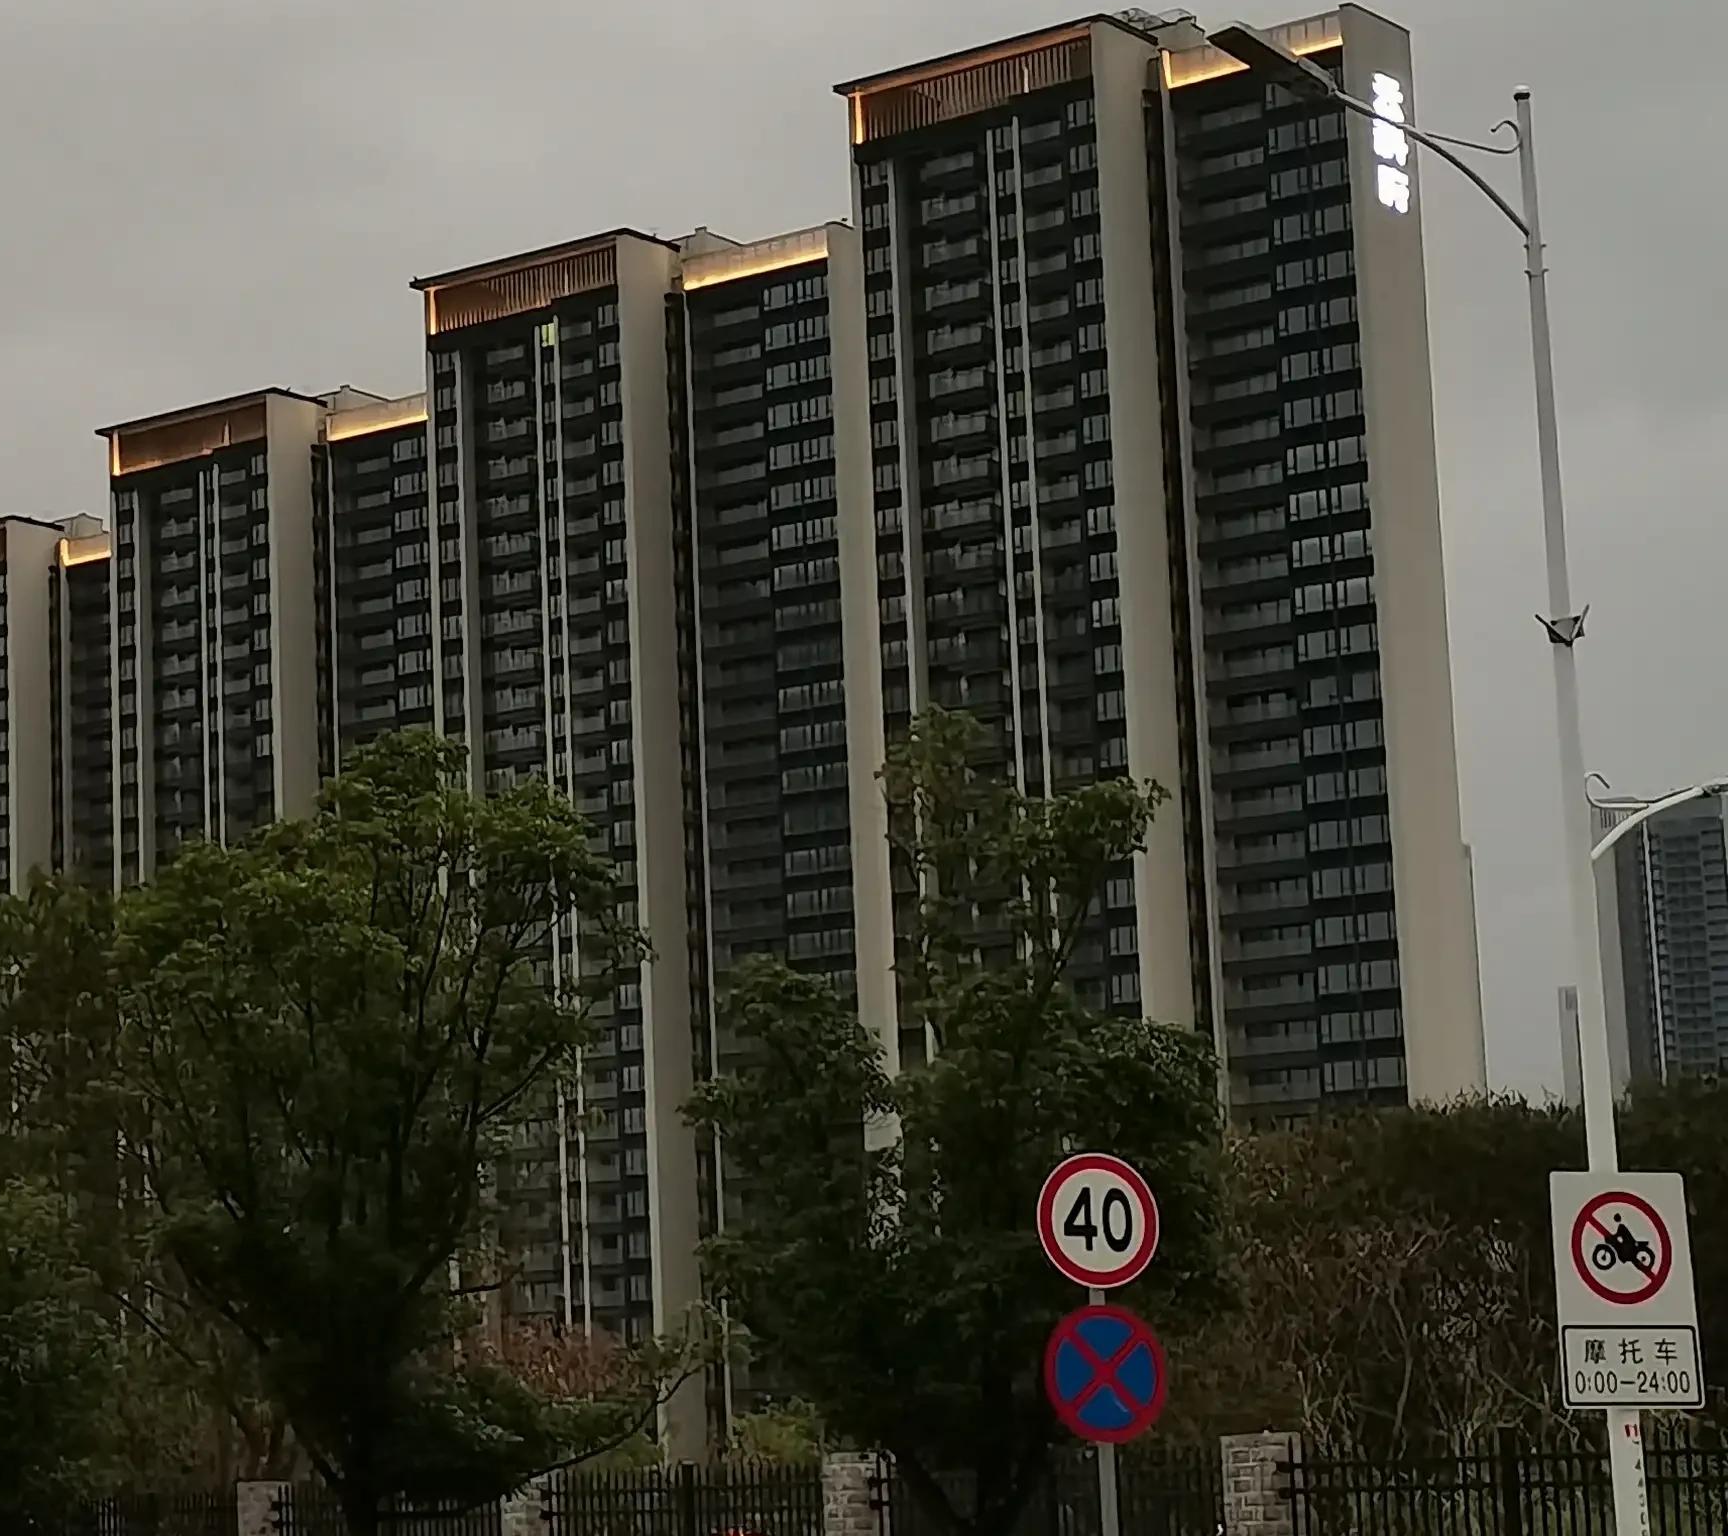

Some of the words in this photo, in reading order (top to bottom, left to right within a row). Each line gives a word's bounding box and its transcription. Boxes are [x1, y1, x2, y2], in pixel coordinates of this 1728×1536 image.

[1063, 1186, 1133, 1252] 40
[1583, 1337, 1678, 1366] 摩托车
